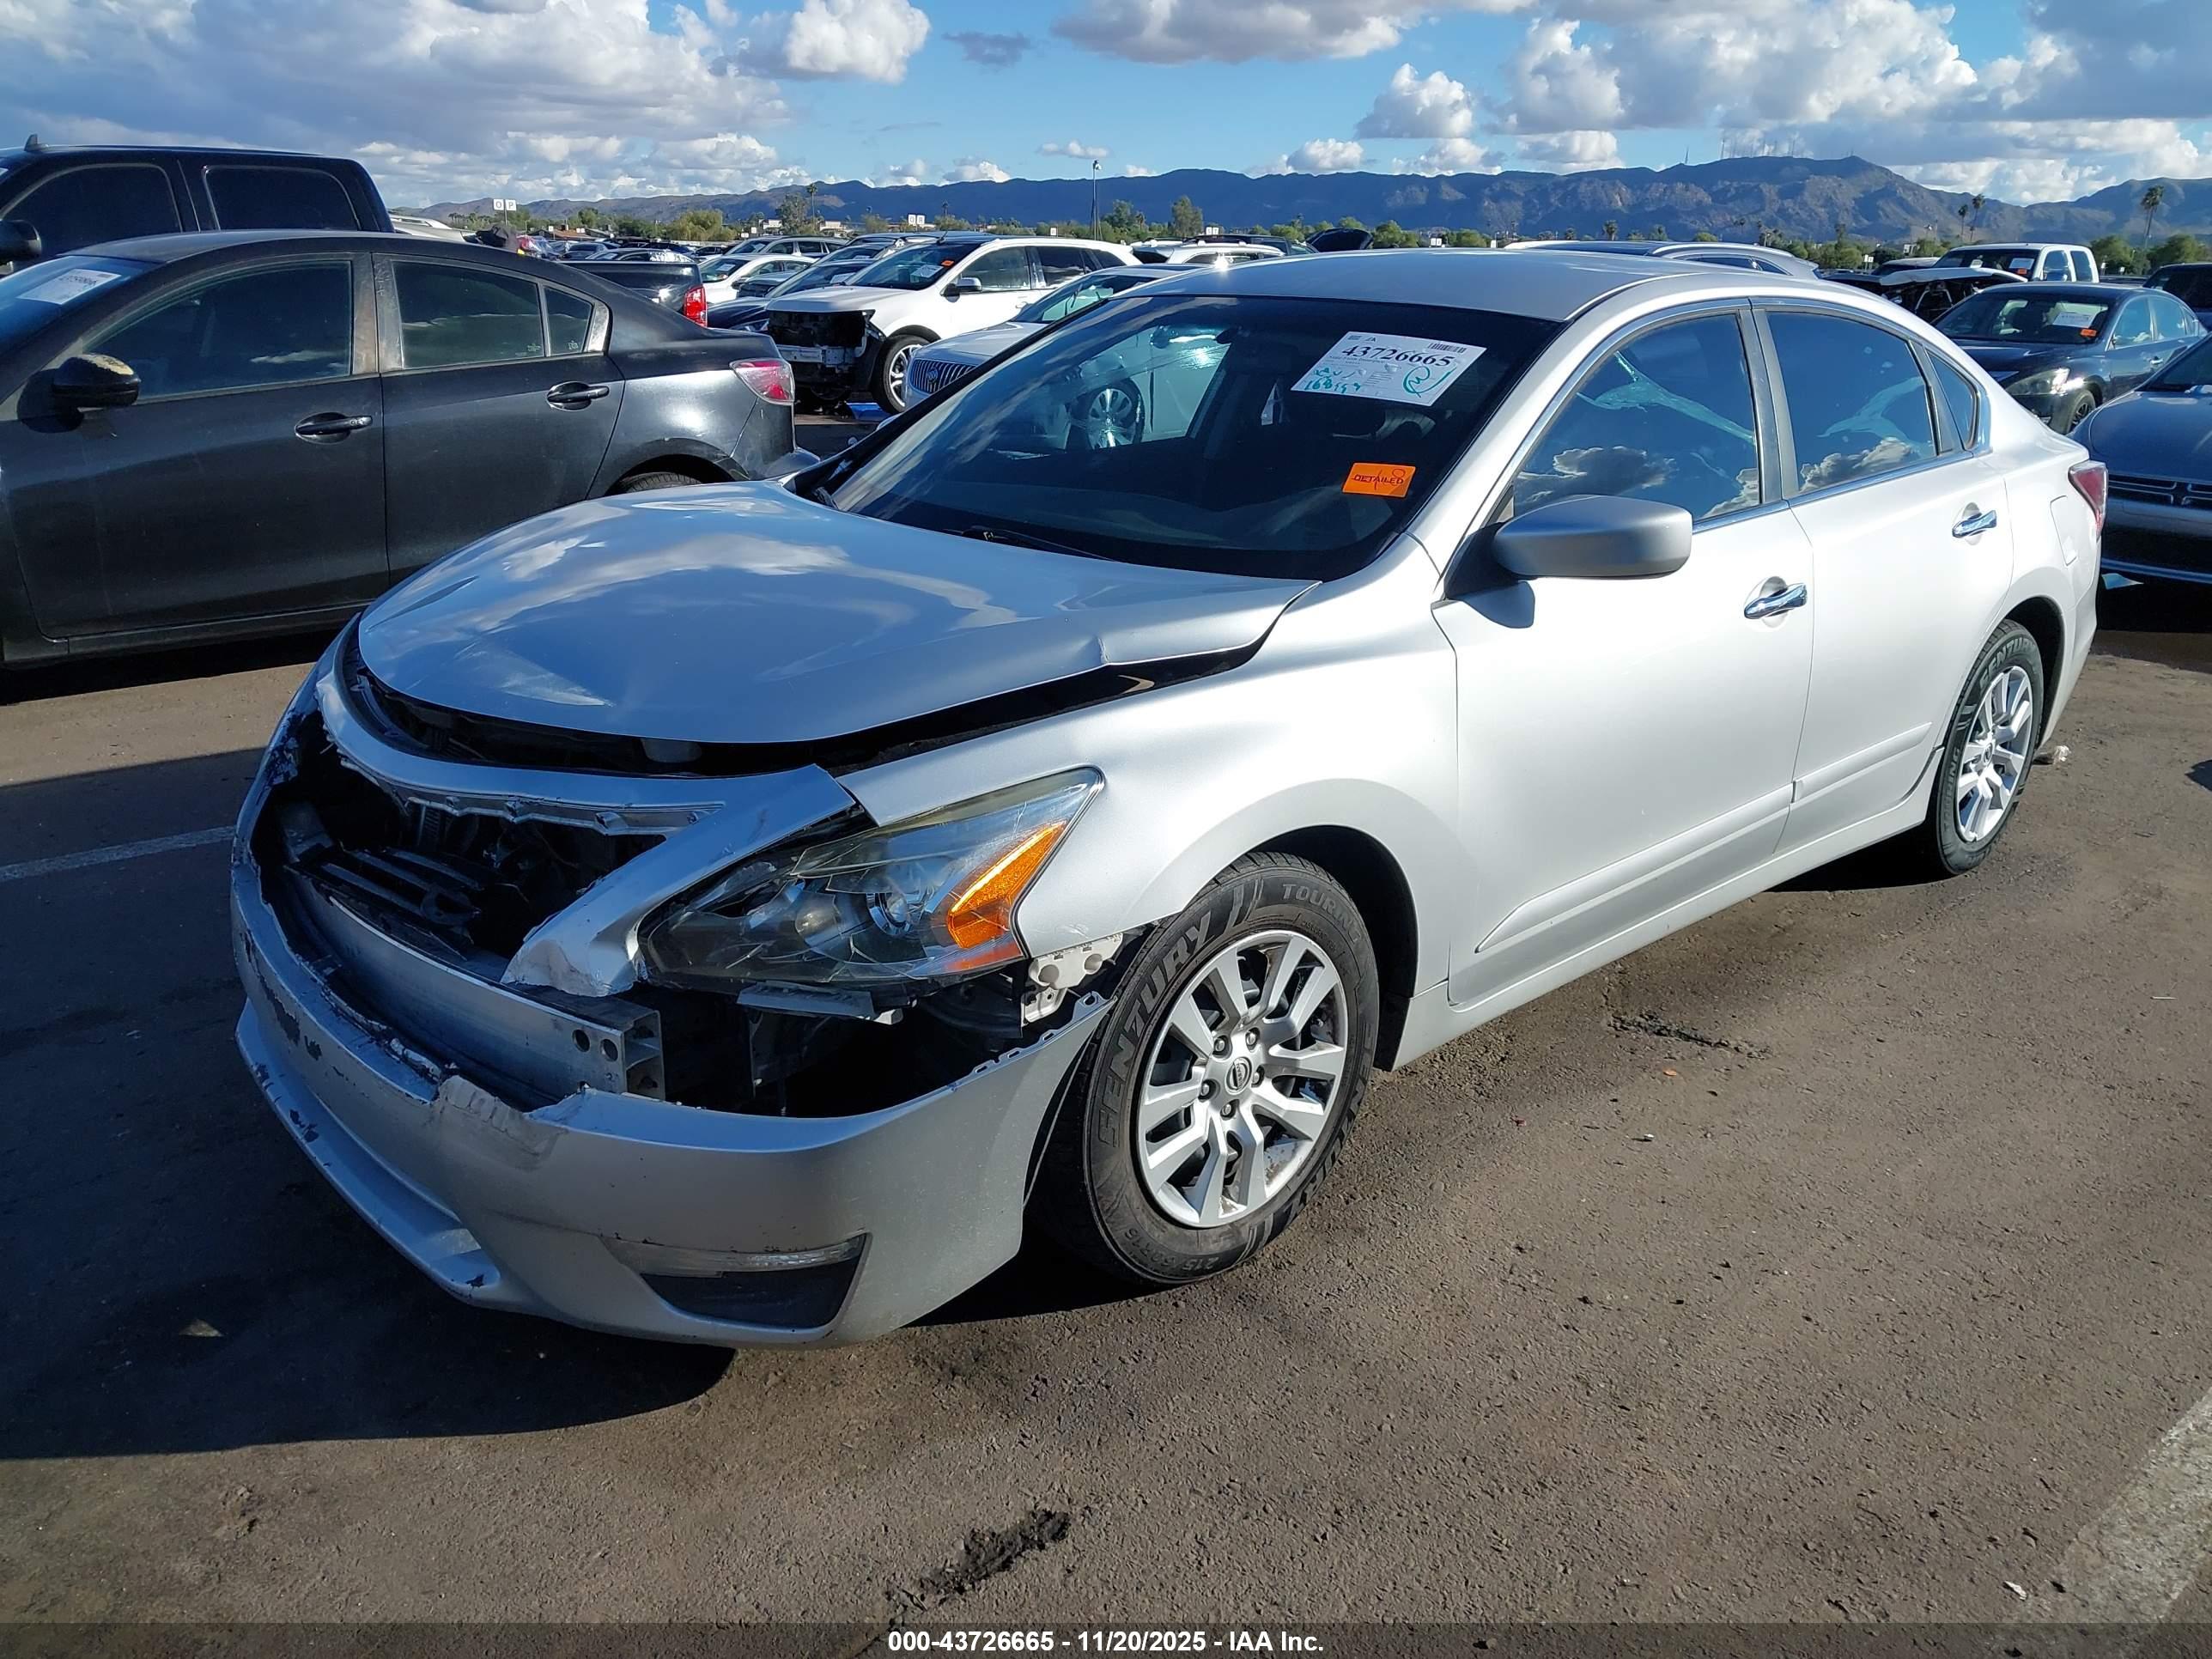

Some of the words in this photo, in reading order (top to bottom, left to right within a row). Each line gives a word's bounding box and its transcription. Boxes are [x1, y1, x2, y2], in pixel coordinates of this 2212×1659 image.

[1341, 345, 1455, 367] 43726665
[1354, 473, 1404, 484] DETAILED
[1281, 883, 1362, 945] TOURING
[1098, 910, 1212, 1149] SENTURY
